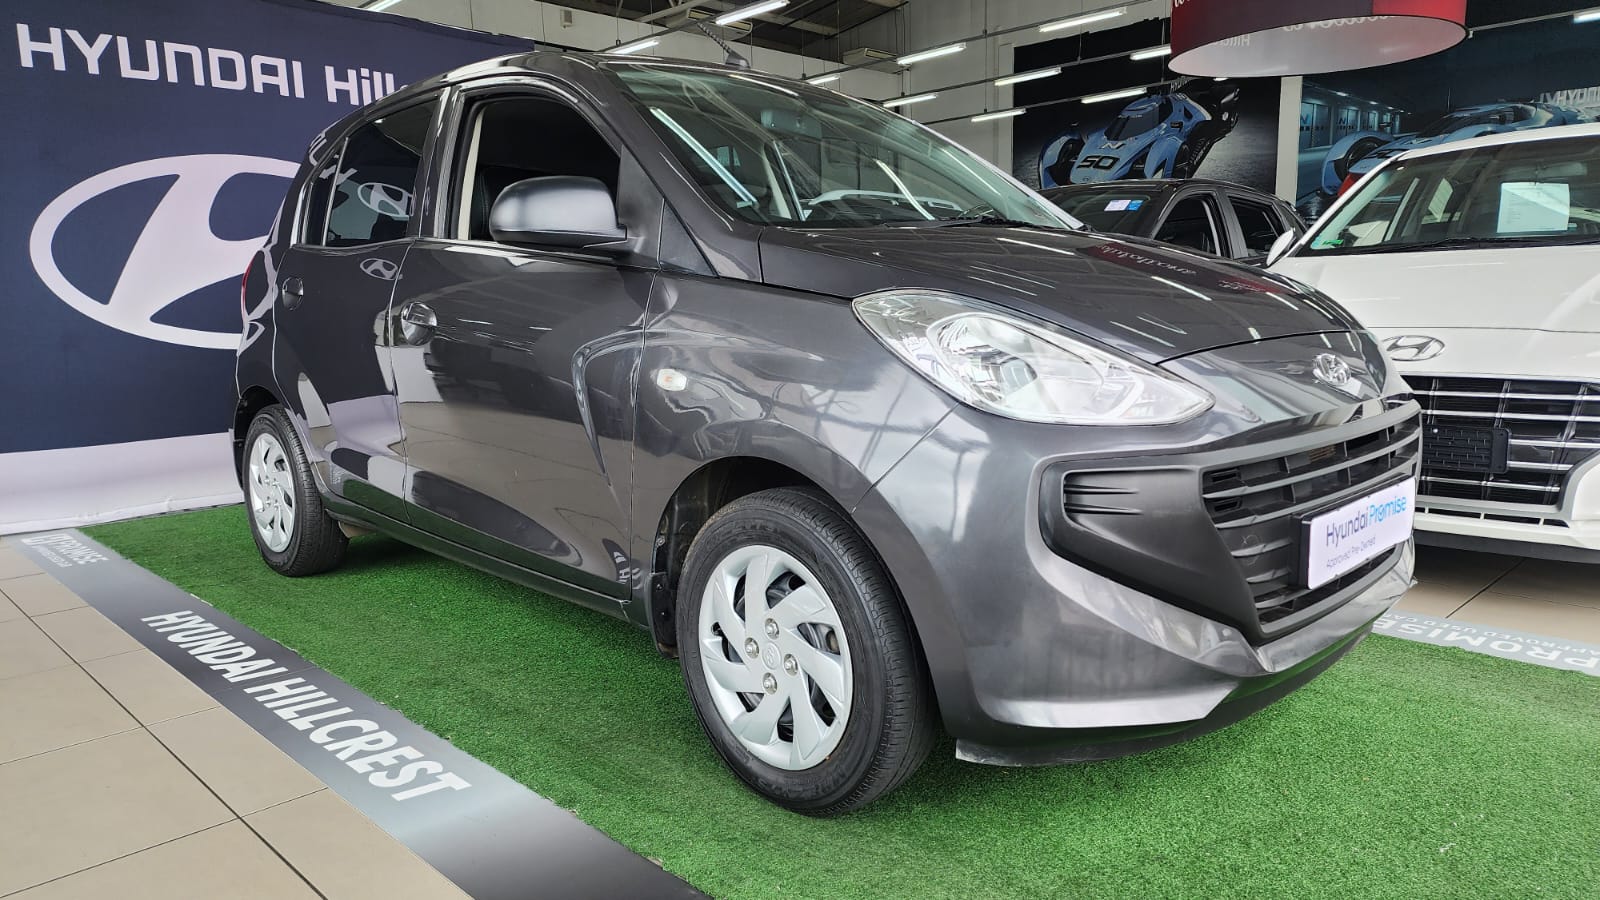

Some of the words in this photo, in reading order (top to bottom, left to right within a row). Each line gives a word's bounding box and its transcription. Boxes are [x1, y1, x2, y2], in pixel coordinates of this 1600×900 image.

[16, 23, 305, 98] HYUNDAI
[1076, 155, 1121, 170] 50
[1326, 510, 1368, 547] Hyundai
[1369, 496, 1407, 524] Promise
[141, 610, 288, 684] HYUNDAI
[1373, 619, 1599, 668] PROMISE
[244, 677, 473, 802] HILLCREST
